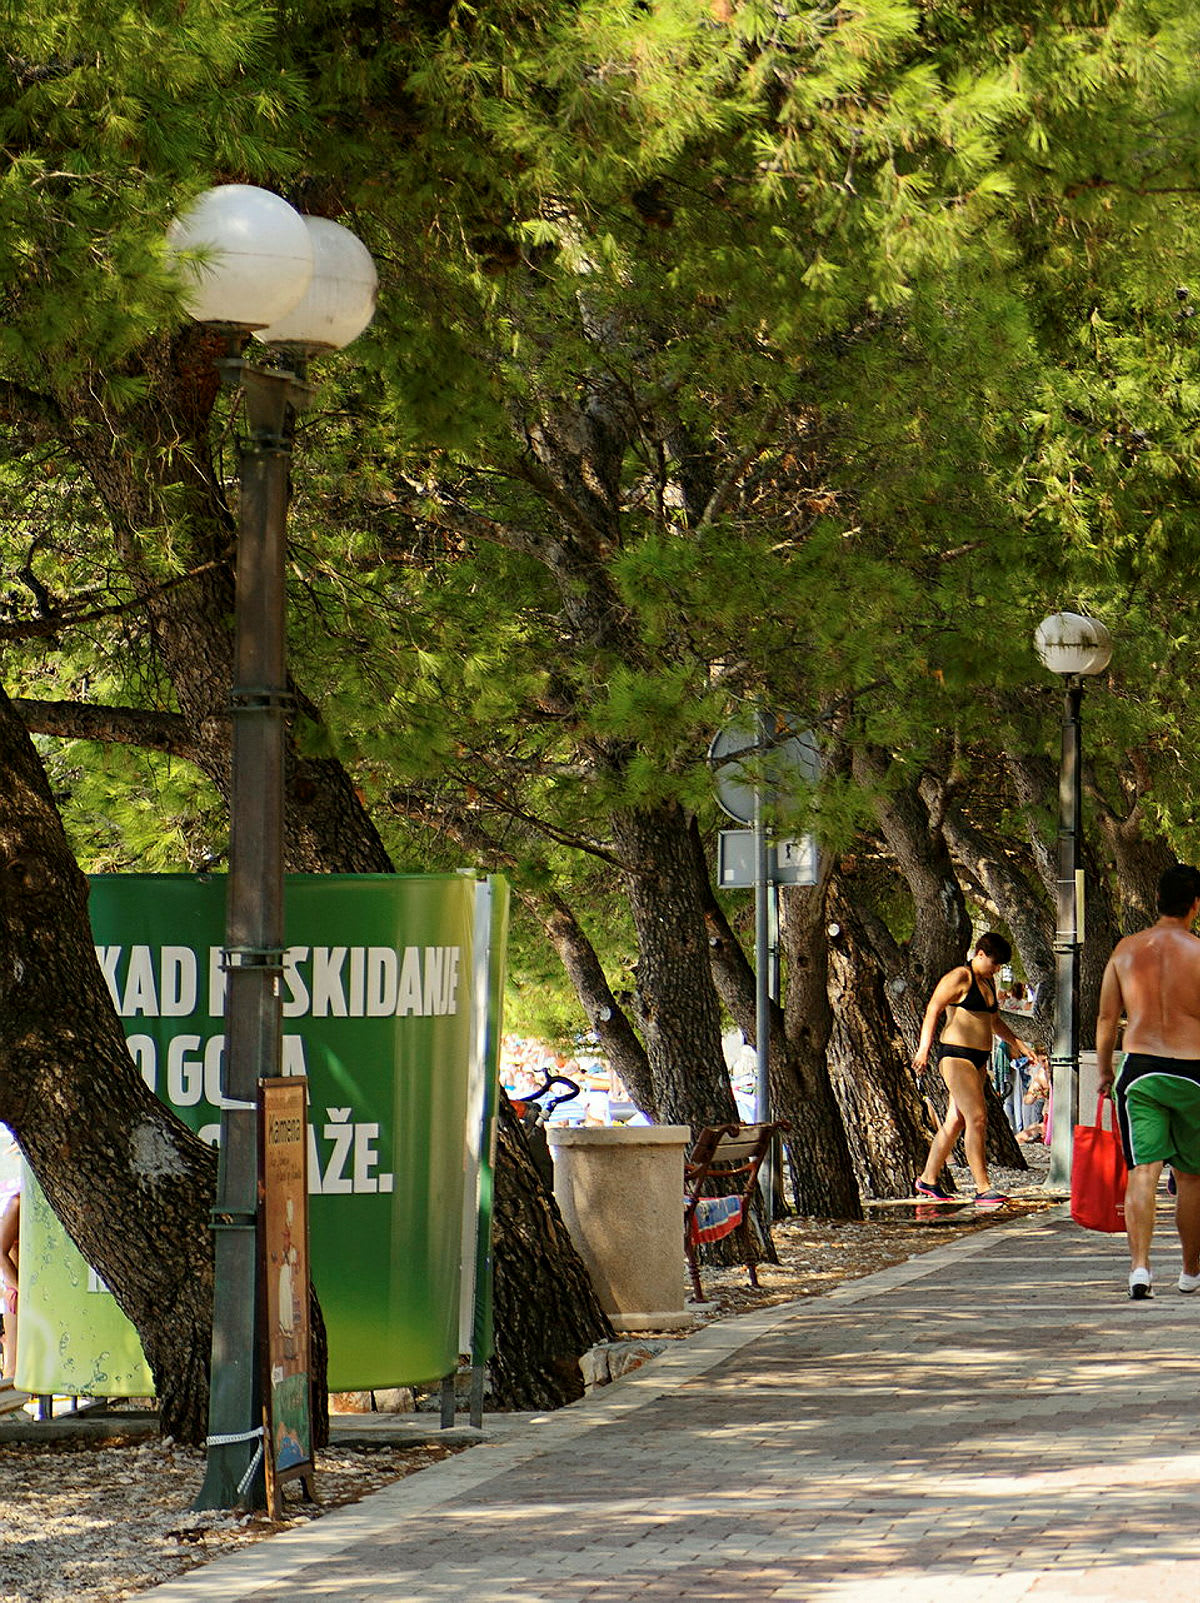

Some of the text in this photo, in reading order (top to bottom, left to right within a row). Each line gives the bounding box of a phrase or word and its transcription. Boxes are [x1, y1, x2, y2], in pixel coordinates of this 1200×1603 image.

[94, 945, 198, 1017] KAD
[282, 945, 460, 1018] SKIDANJE
[167, 1034, 311, 1107] GOA
